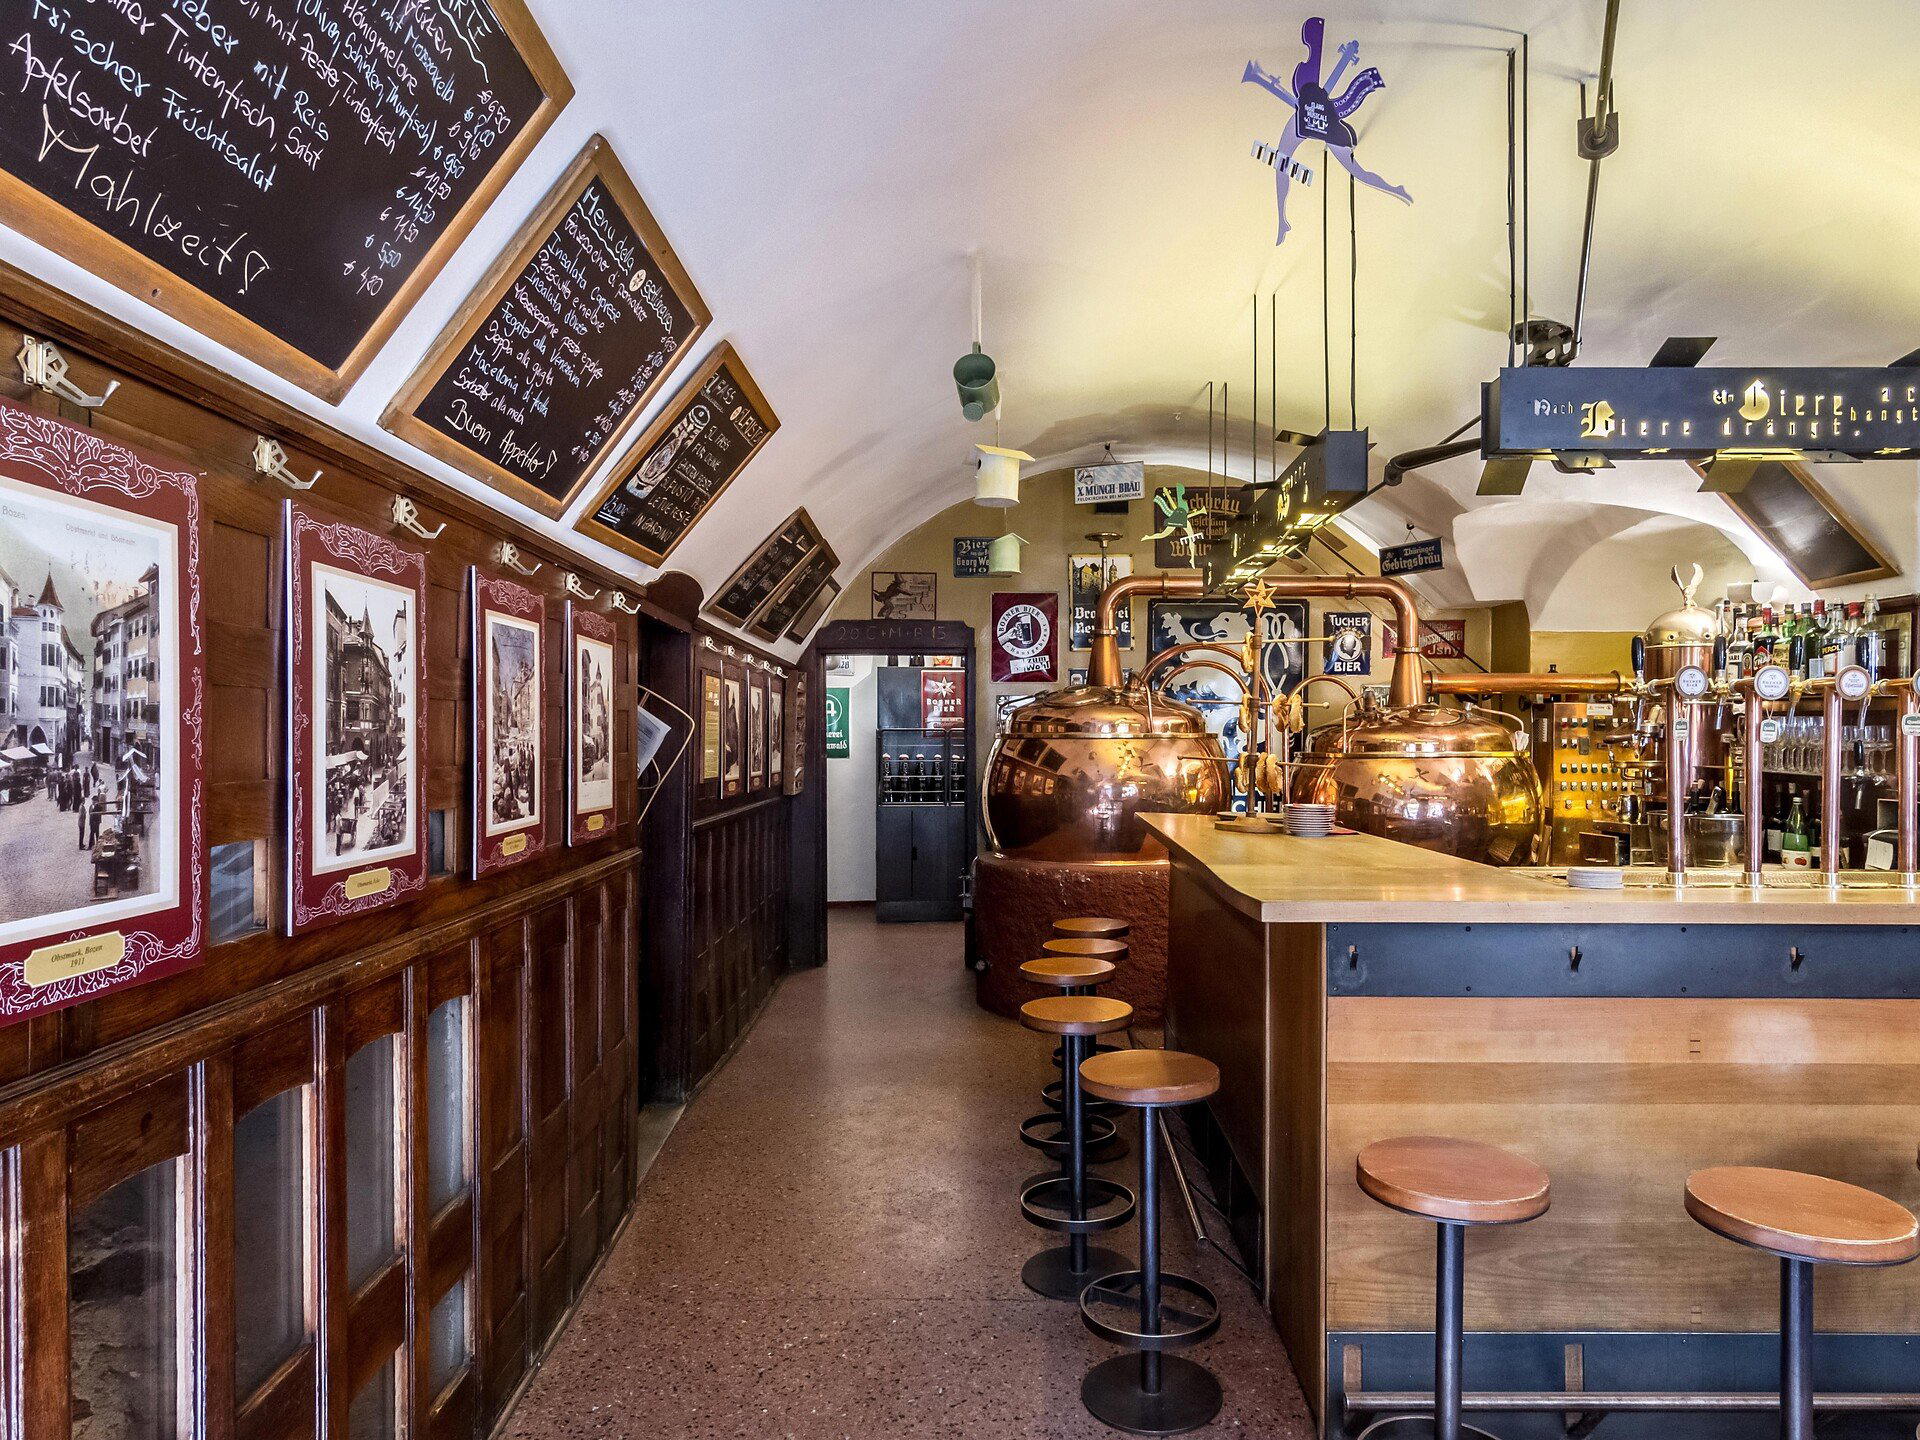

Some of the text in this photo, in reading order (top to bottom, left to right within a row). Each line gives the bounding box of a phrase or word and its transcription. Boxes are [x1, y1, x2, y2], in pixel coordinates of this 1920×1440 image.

[266, 5, 298, 46] mit
[172, 0, 239, 54] eber
[254, 60, 288, 100] mit
[294, 91, 330, 141] Reis
[583, 186, 616, 242] Menu
[547, 231, 588, 290] Insalata
[524, 263, 562, 315] Insalata
[445, 398, 493, 445] Buon
[1328, 614, 1368, 627] TUCHER
[1333, 660, 1362, 672] BIER
